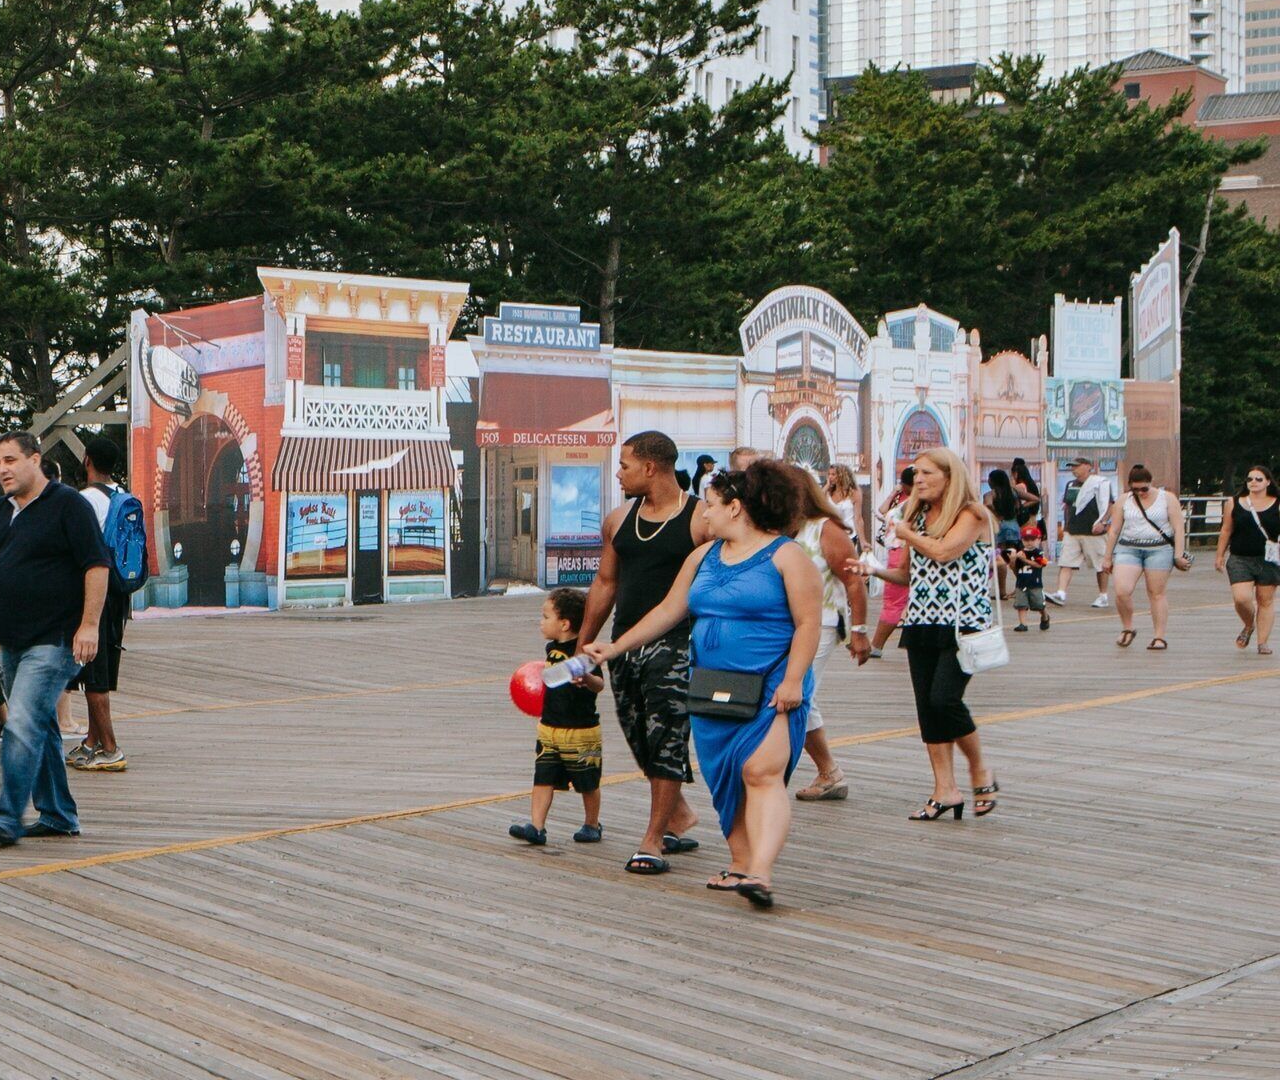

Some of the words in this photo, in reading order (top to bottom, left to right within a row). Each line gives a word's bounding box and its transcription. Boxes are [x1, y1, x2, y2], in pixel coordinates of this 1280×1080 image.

[492, 324, 595, 347] RESTAURANT
[745, 296, 819, 352] BOARDWALK
[823, 301, 865, 360] EMPIRE
[481, 433, 500, 443] 1503
[513, 433, 587, 444] DELICATESSEN
[597, 434, 614, 444] 1503
[1066, 430, 1077, 439] SALT
[1078, 430, 1093, 439] WATER
[559, 556, 582, 571] AREA'S
